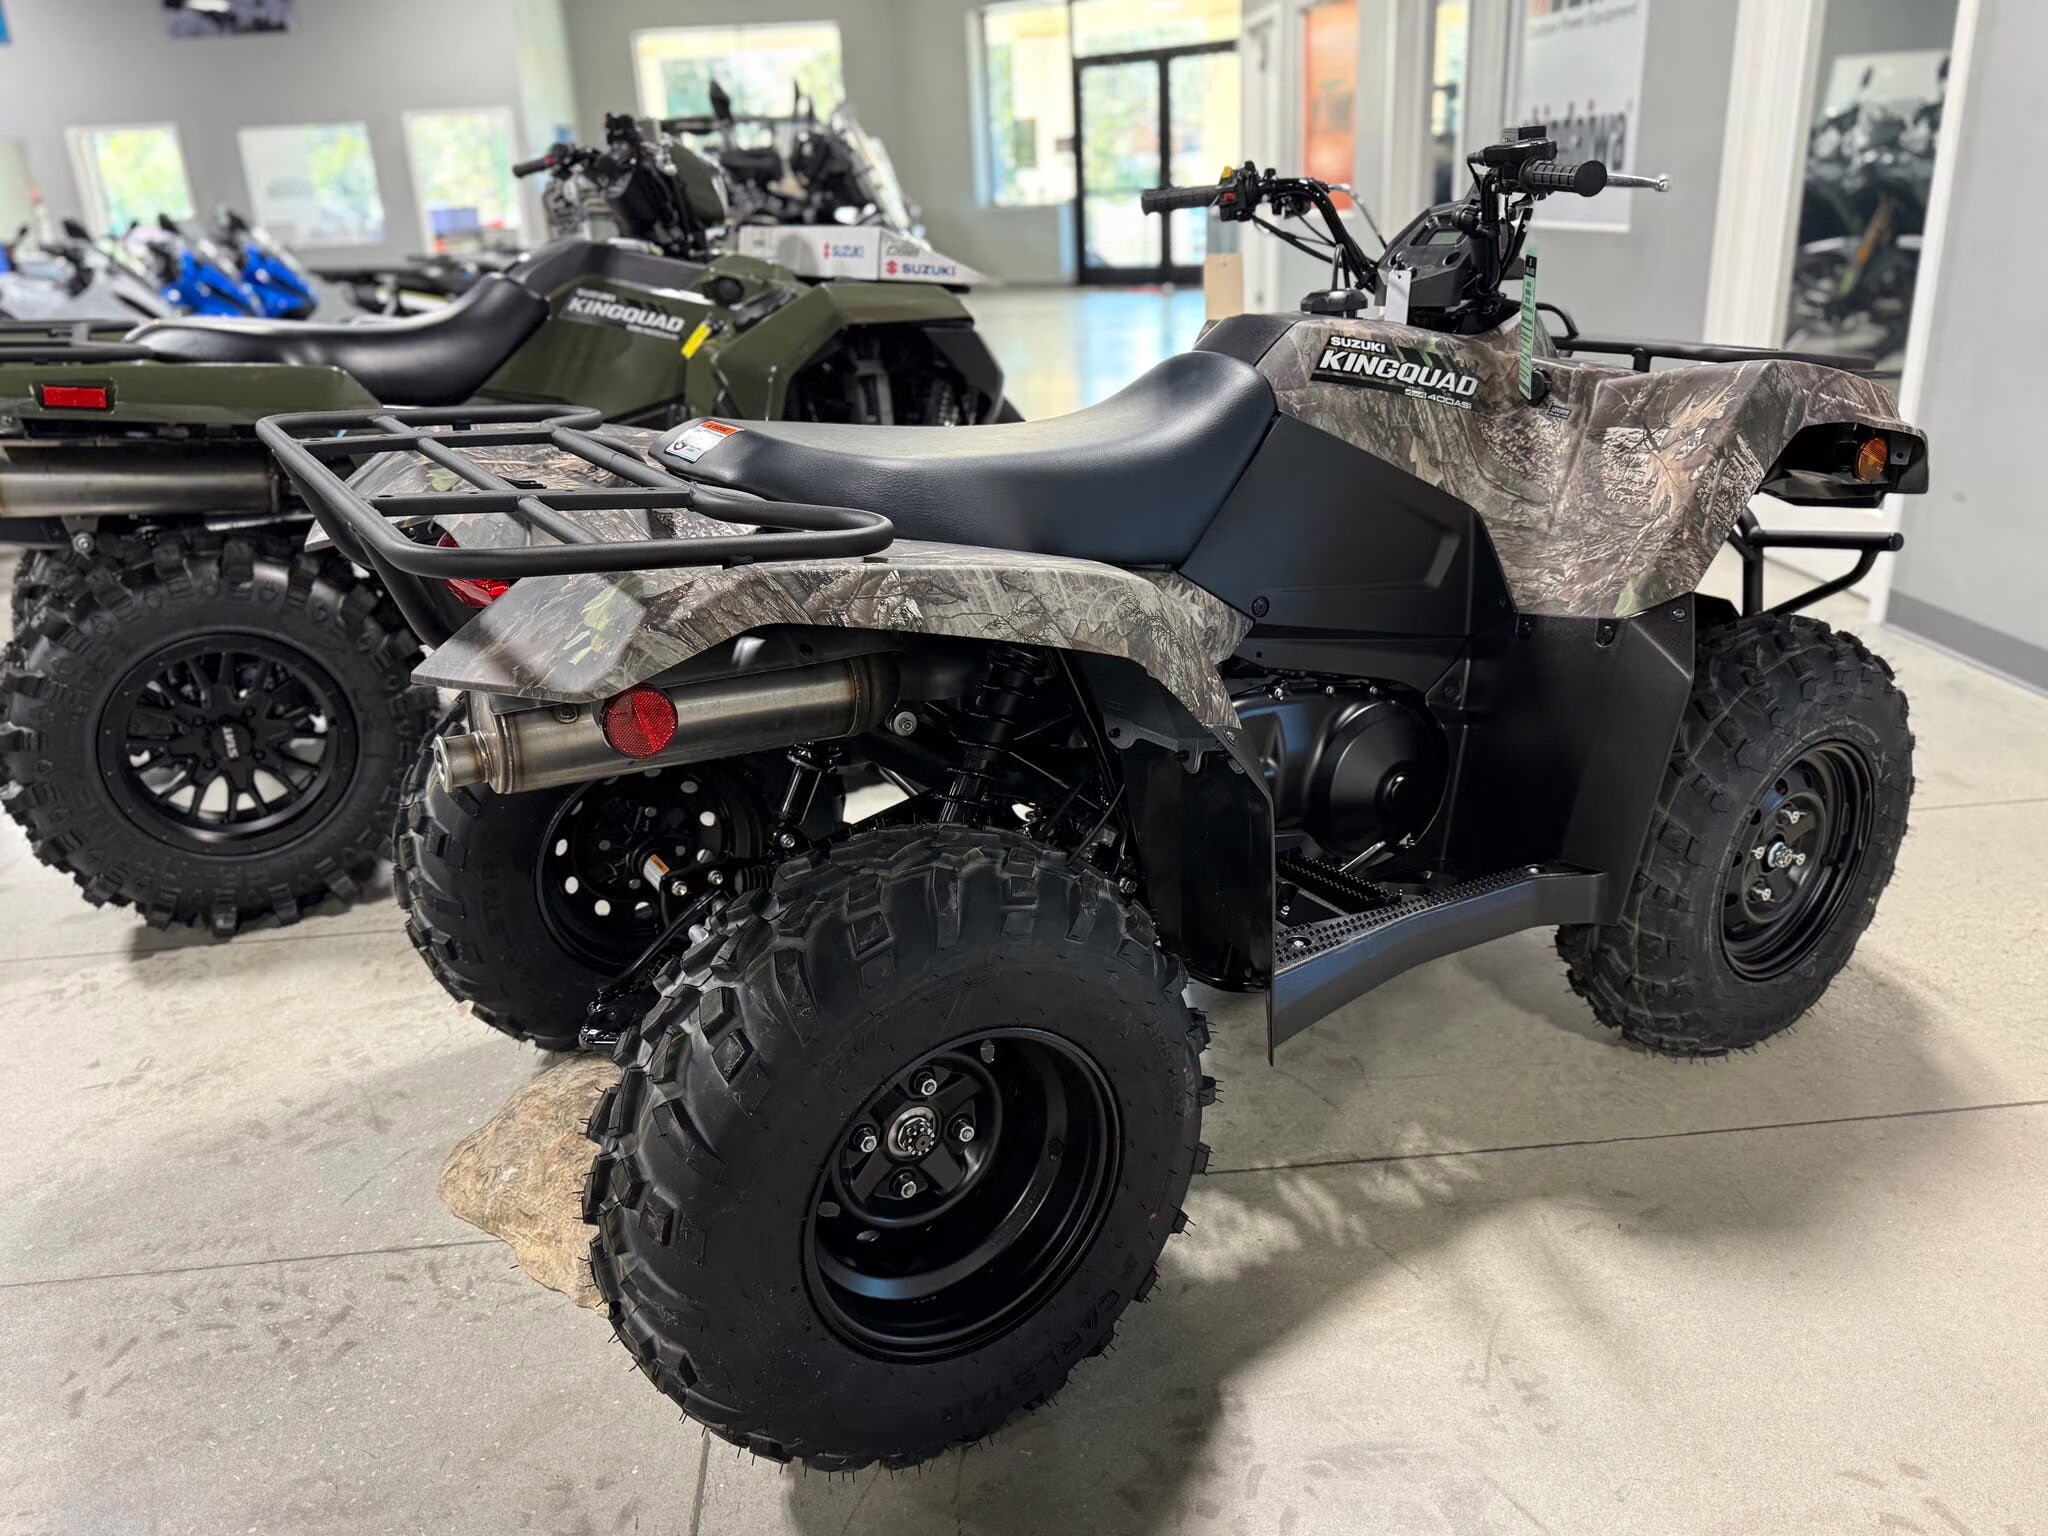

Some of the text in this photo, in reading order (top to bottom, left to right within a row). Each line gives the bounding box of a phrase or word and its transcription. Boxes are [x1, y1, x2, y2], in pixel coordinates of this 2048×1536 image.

[902, 263, 956, 277] SUZUKI
[567, 296, 686, 332] KINGQUAD
[1330, 336, 1386, 353] SUZUKI
[1319, 349, 1479, 397] KINGQUAD
